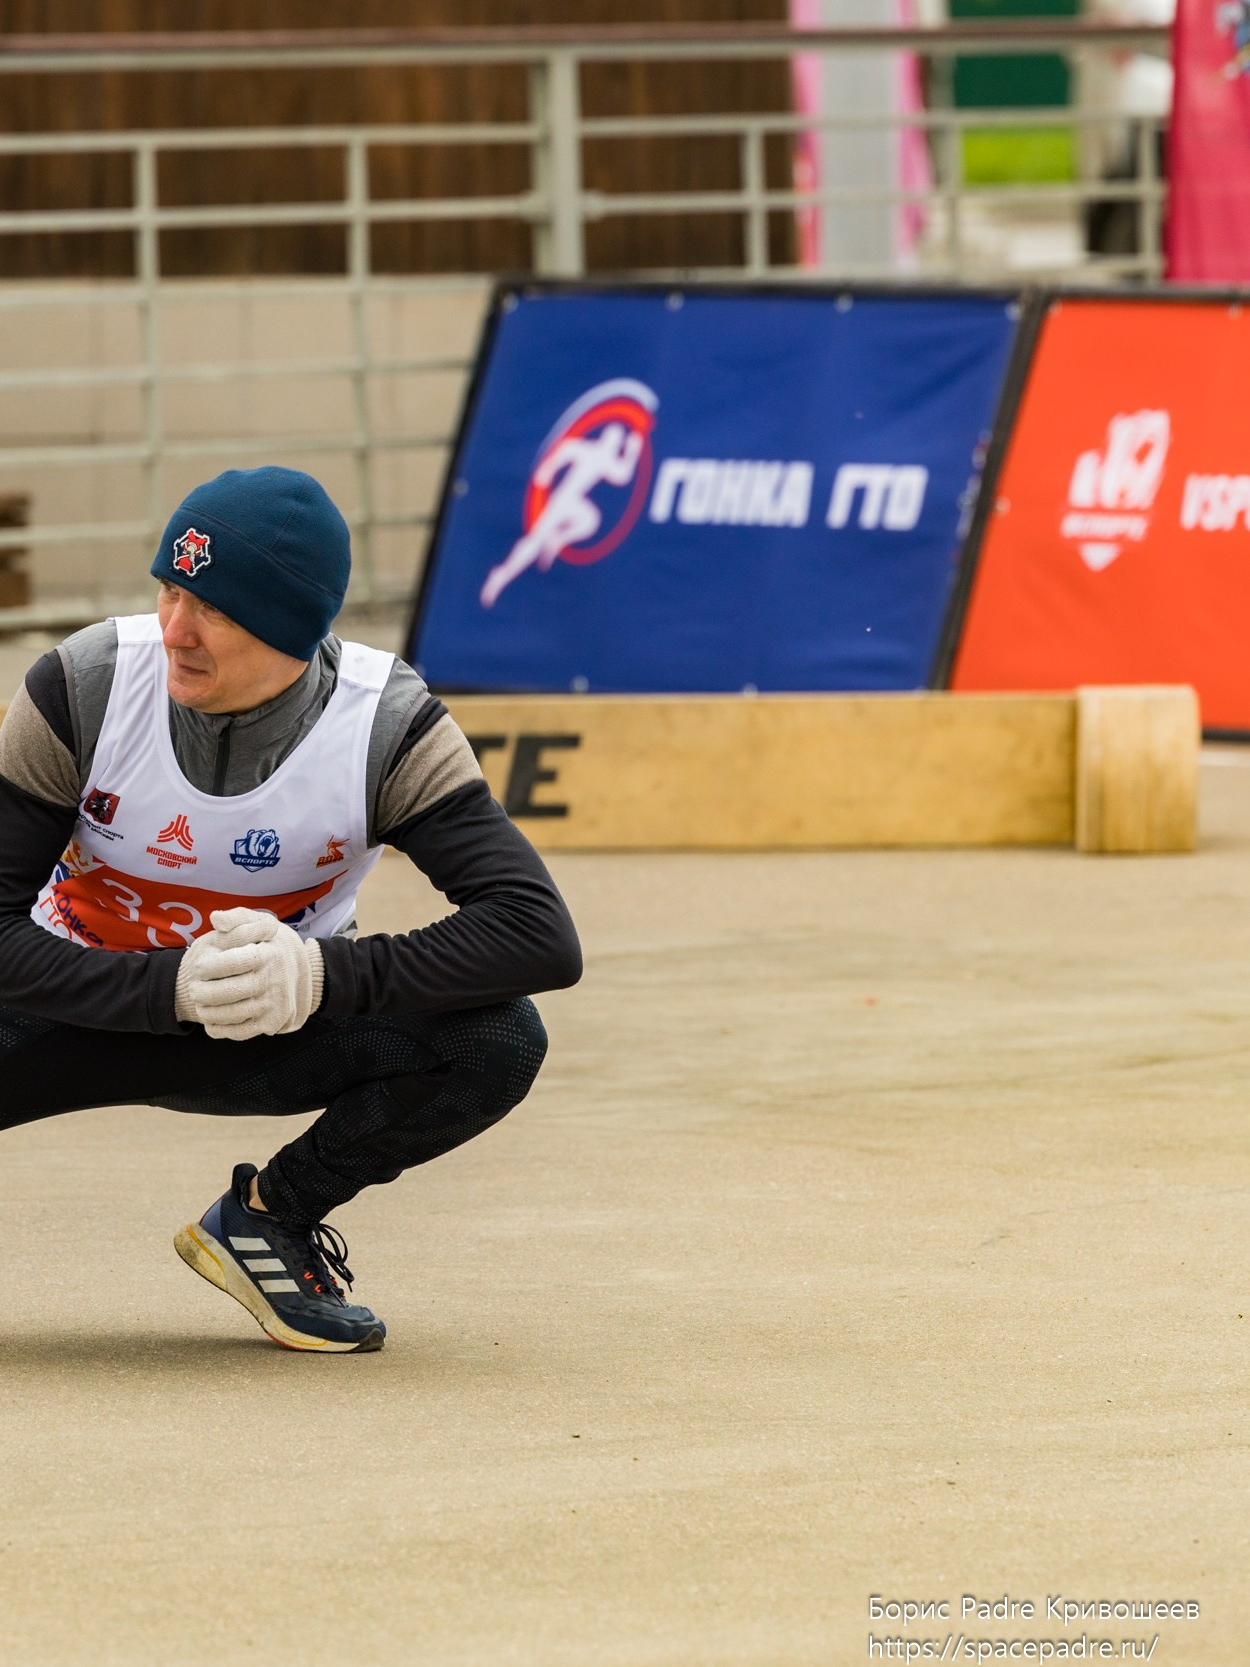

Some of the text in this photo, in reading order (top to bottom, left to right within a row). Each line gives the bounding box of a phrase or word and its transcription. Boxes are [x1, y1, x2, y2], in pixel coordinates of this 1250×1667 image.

[649, 457, 929, 531] ГОНКА ГТО
[1180, 473, 1250, 531] VSP
[146, 846, 198, 865] МОСКОВСКИЙ
[157, 857, 182, 870] СПОРТ
[234, 856, 276, 866] ВСПОРТЕ
[95, 878, 279, 948] 33
